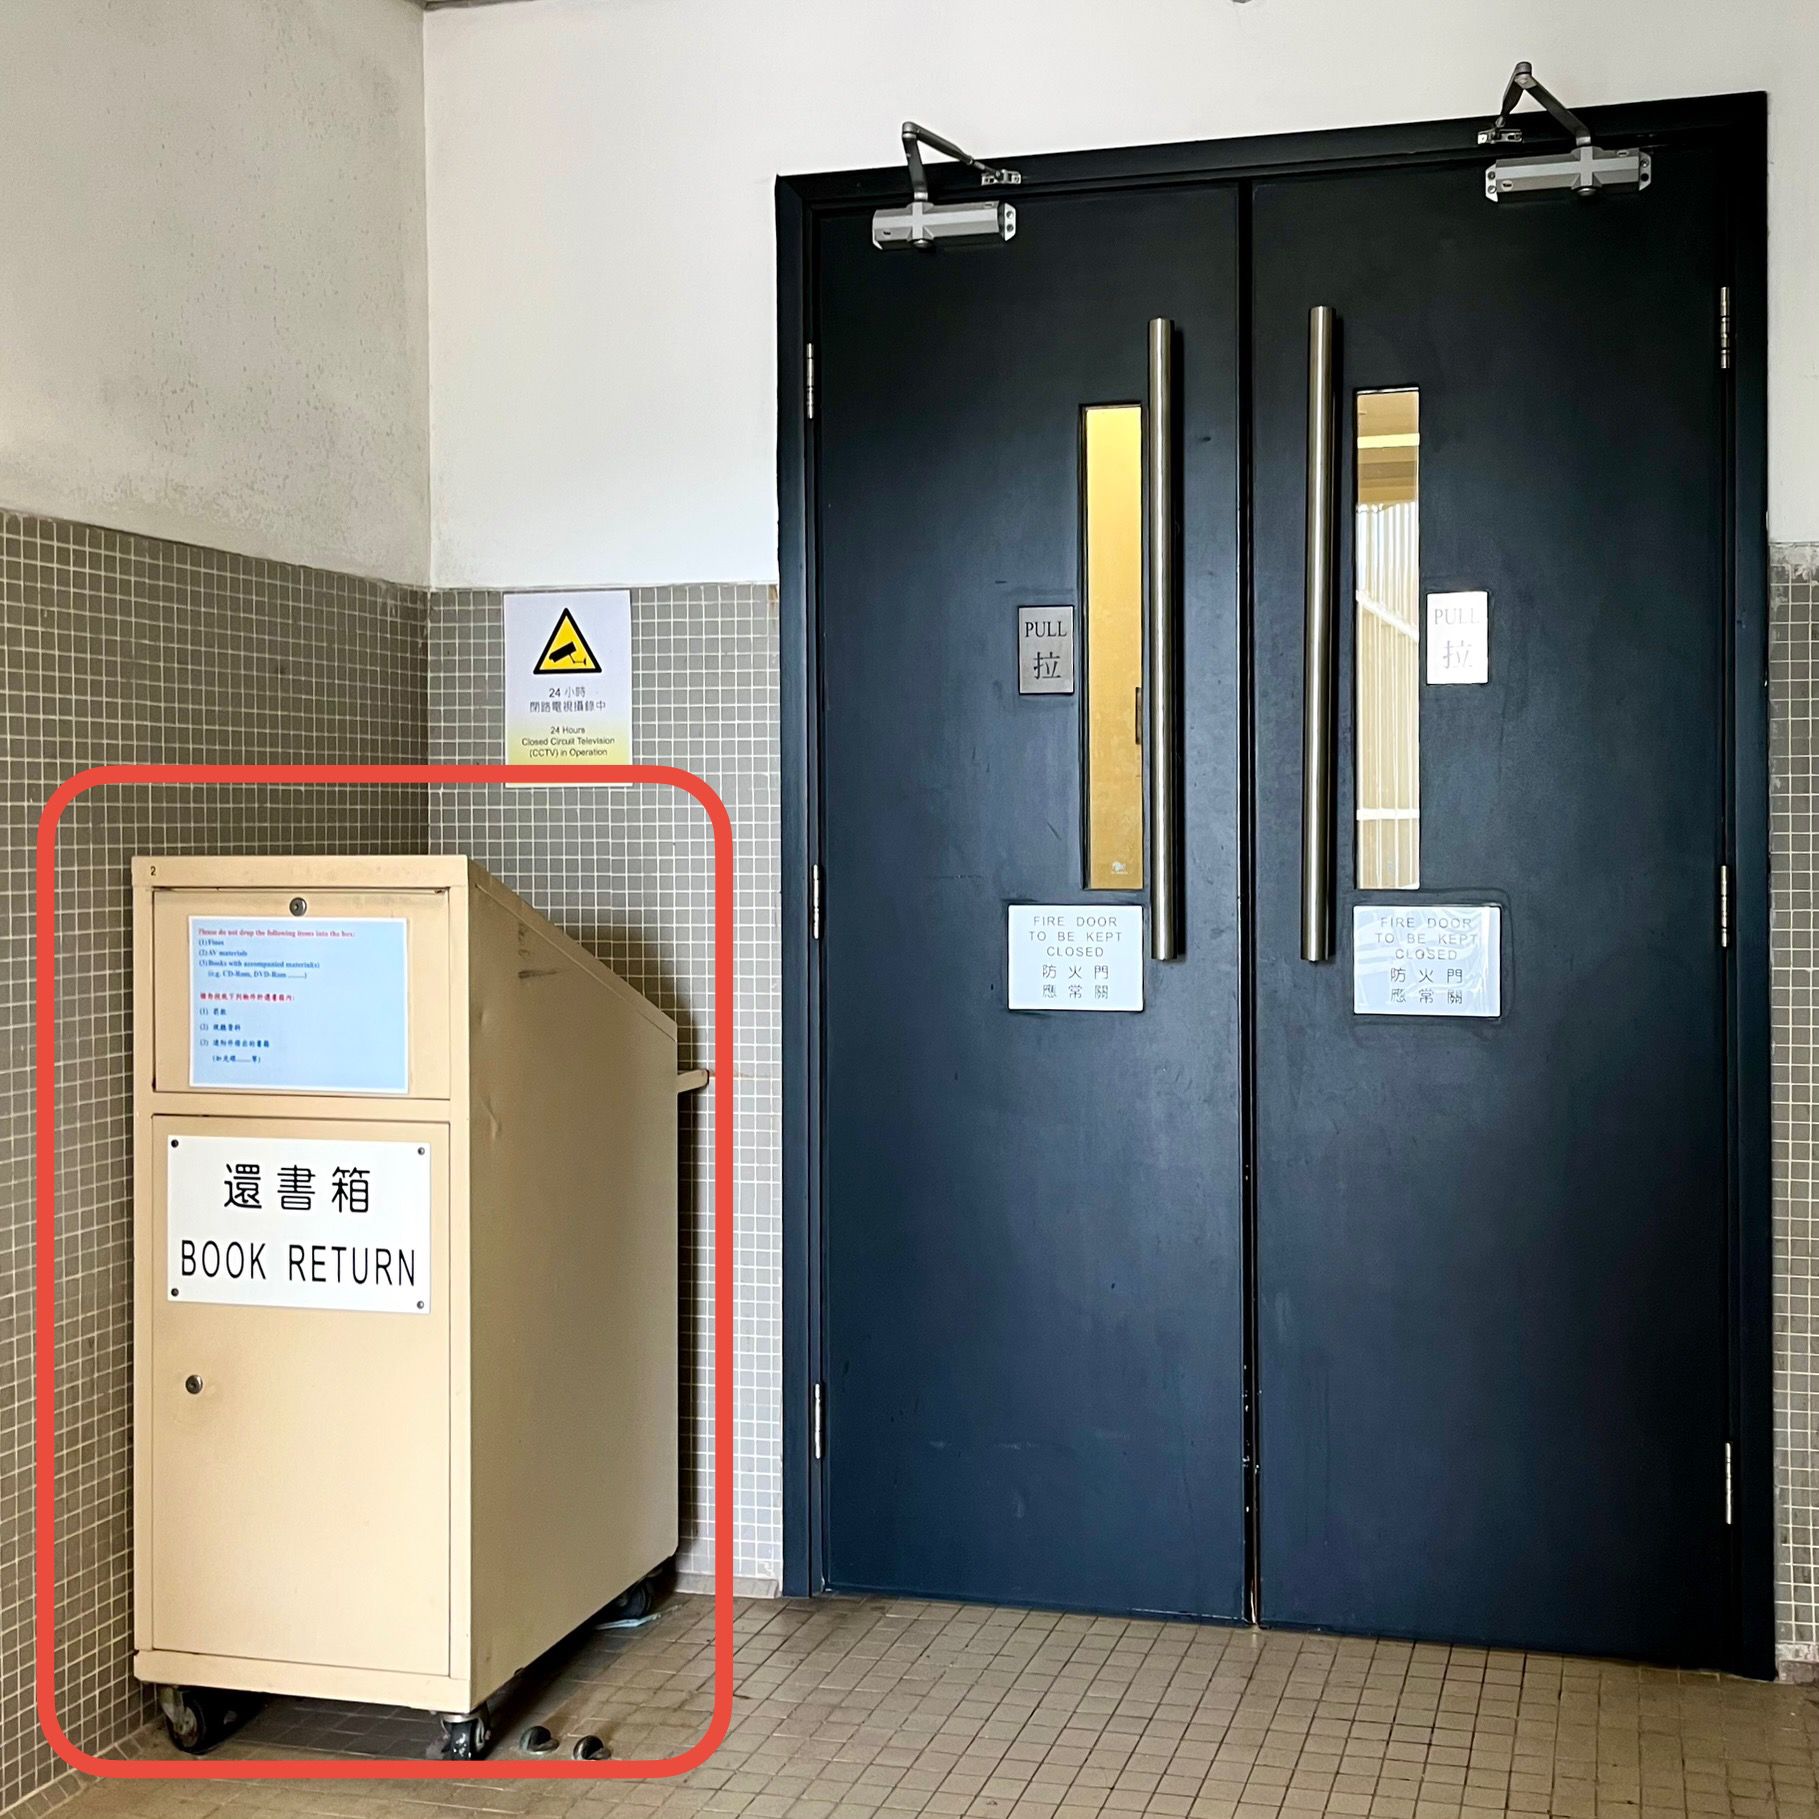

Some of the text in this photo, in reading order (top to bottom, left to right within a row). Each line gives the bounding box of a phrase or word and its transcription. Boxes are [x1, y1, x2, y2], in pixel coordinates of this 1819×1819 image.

[1434, 608, 1480, 625] PULL
[1025, 621, 1067, 638] PULL
[1443, 640, 1472, 669] 拉
[1033, 651, 1061, 680] 拉
[548, 686, 586, 698] 24 小時
[550, 725, 586, 735] 24 Hours
[521, 736, 616, 746] Closed Circuit Television
[529, 747, 608, 758] (CCTV) in Operation
[150, 865, 157, 876] 2
[1033, 916, 1118, 927] FIRE DOOR
[1380, 917, 1473, 929] FIRE DOOR
[1029, 931, 1122, 942] TO BE KEPT
[1375, 933, 1478, 945] TO BE KEPT
[1046, 946, 1104, 957] CLOSED
[1395, 948, 1457, 960] CLOSED
[1042, 964, 1109, 980] 防火門
[1390, 967, 1463, 983] 防火門
[1042, 984, 1109, 999] 應常關
[224, 1163, 370, 1214] 還書箱
[181, 1239, 415, 1287] BOOK RETURN
